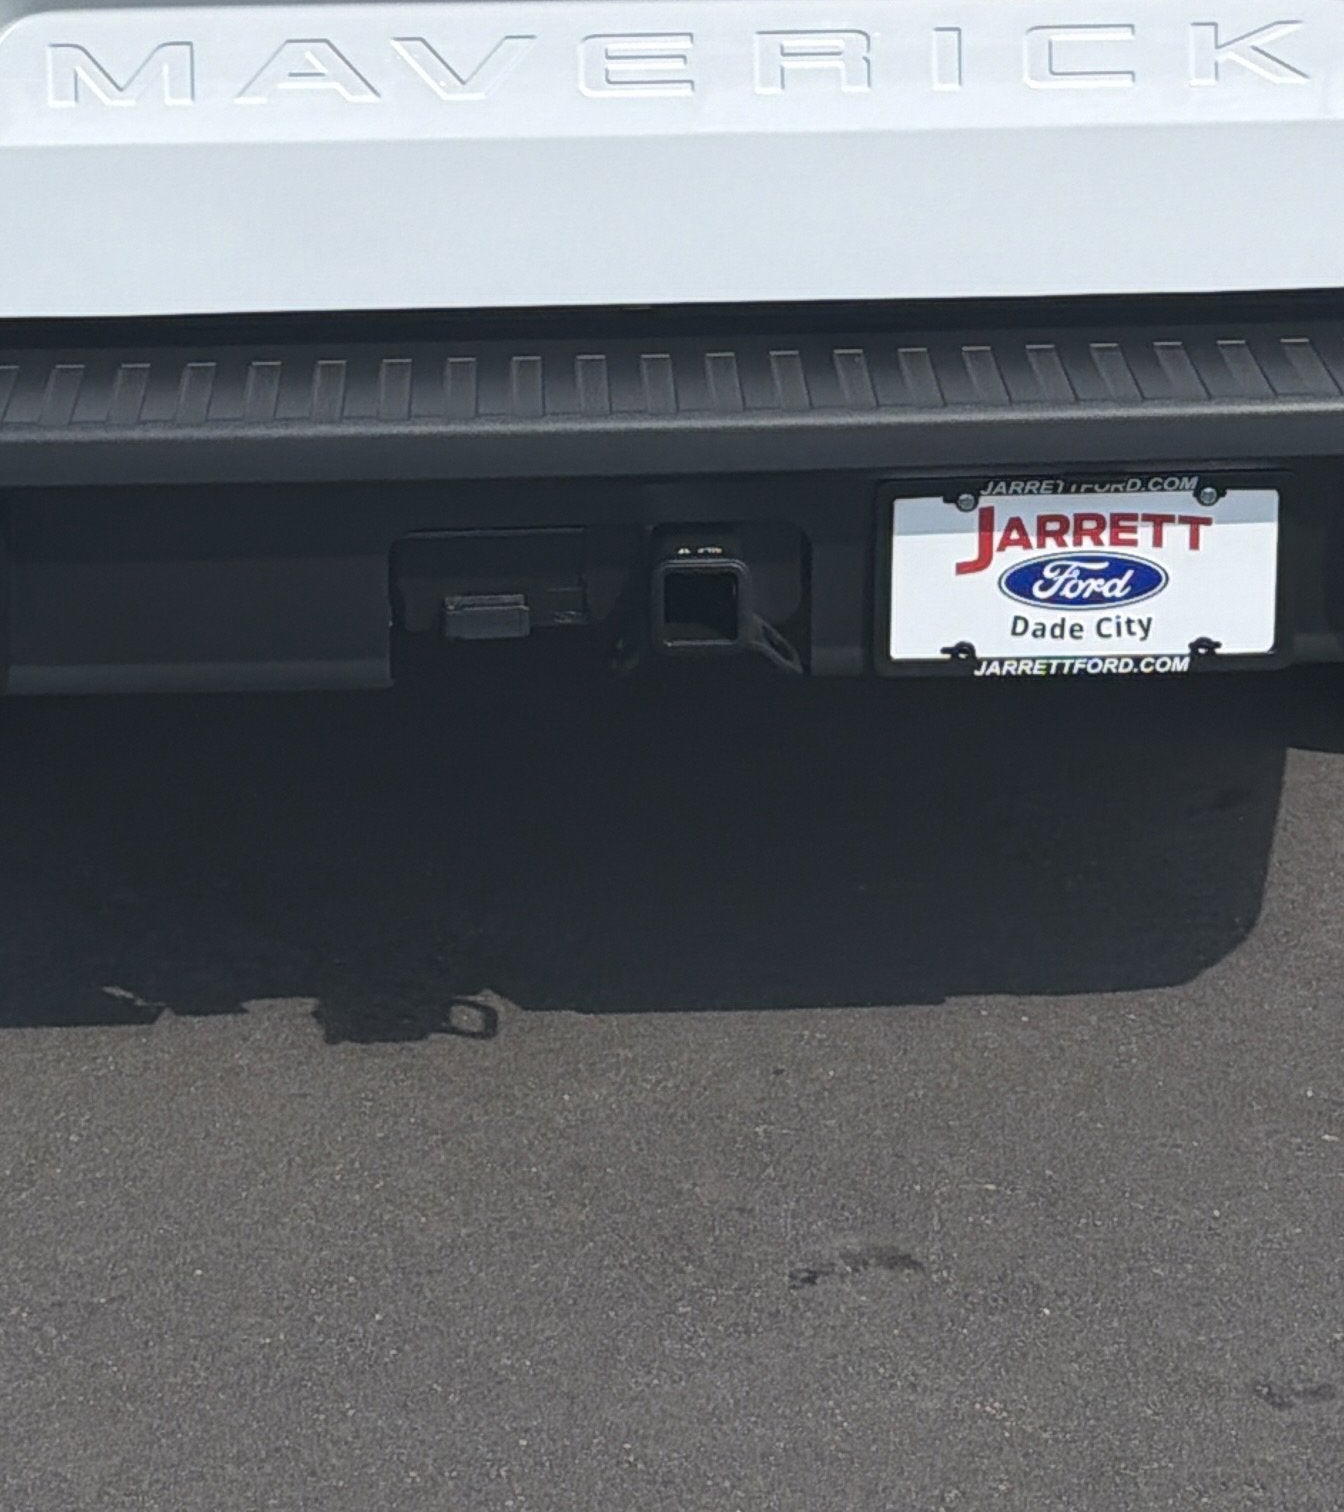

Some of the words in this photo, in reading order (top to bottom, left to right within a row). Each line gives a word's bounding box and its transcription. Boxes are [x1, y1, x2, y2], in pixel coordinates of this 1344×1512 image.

[46, 19, 1312, 109] MAVERICK
[955, 505, 1214, 577] JARRETT
[1031, 560, 1133, 600] Ford
[1010, 615, 1084, 640] Dade
[1095, 615, 1153, 642] City
[973, 656, 1191, 678] JARRETTFORD.COM
